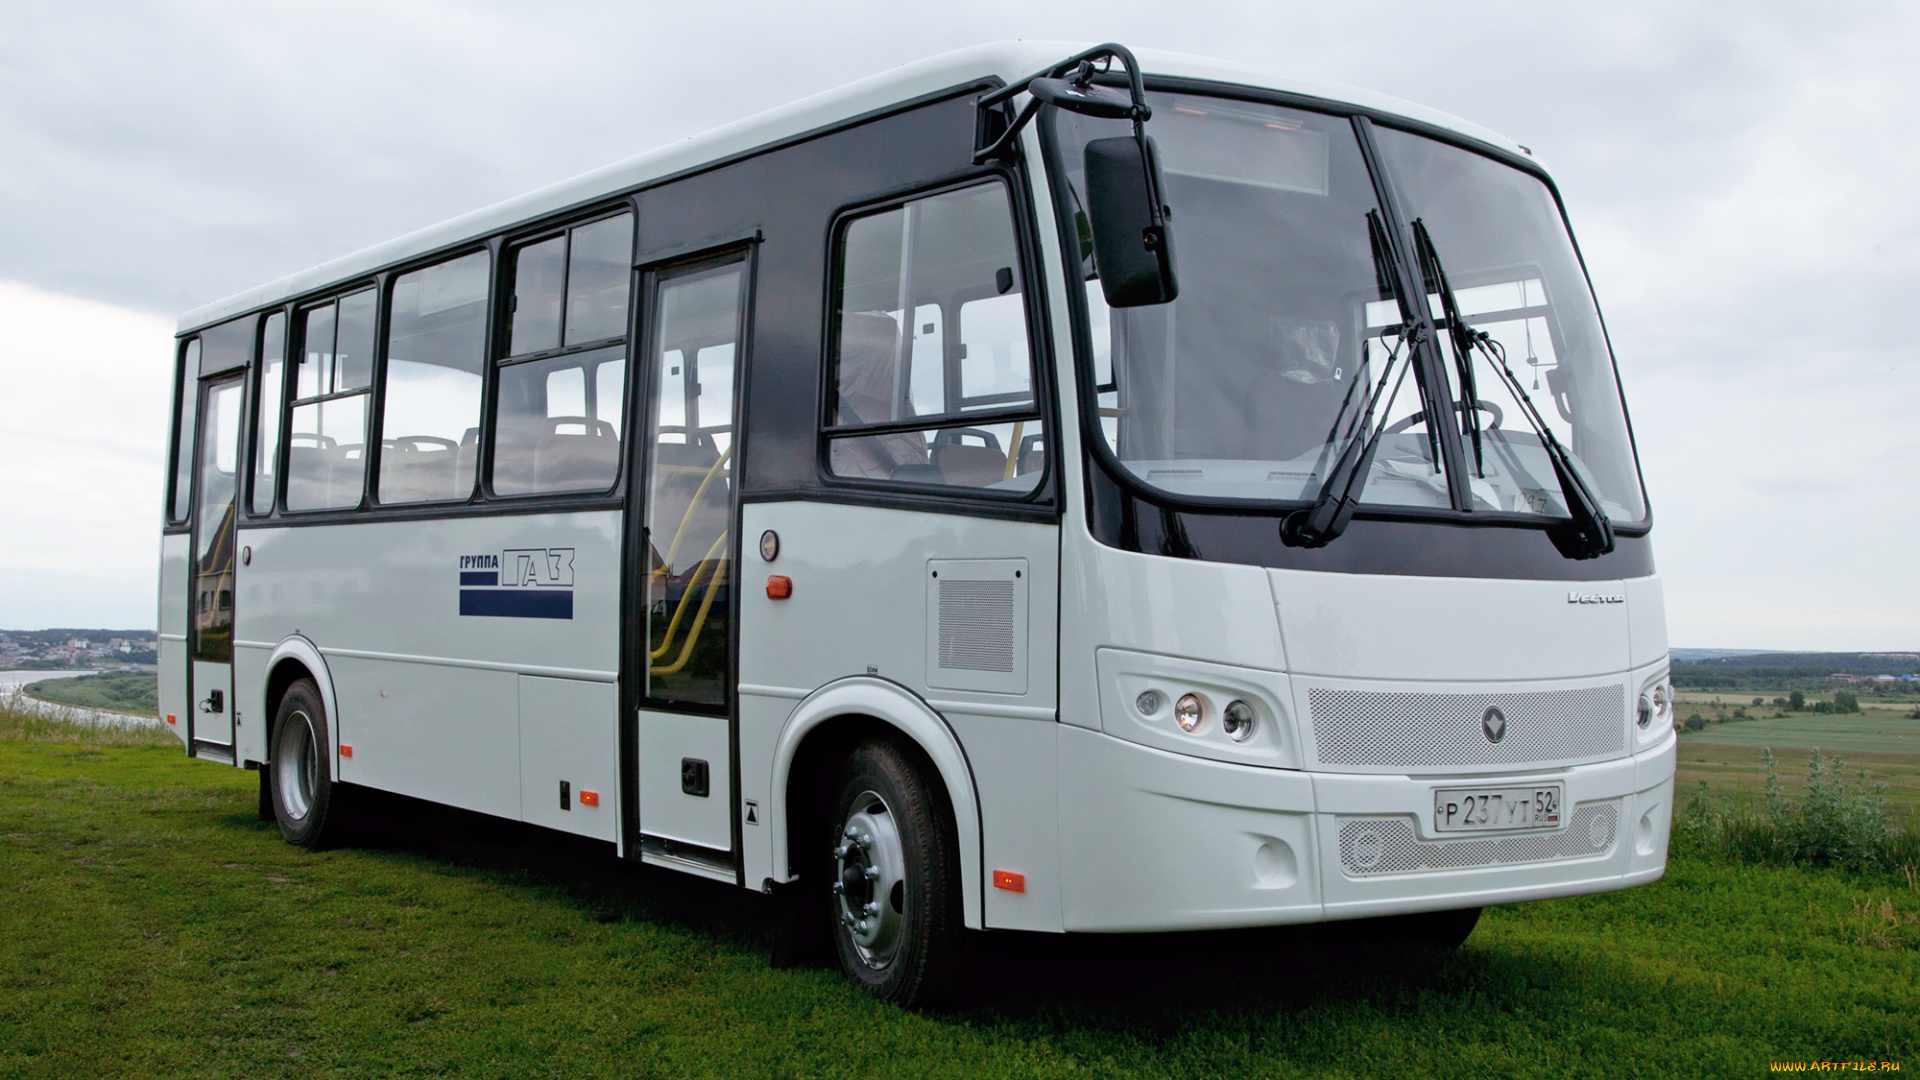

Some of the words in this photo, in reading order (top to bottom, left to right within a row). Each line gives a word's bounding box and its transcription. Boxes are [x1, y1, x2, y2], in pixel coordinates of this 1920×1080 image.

[460, 555, 499, 569] ГРУППА
[502, 547, 575, 587] ГАЗ
[1536, 791, 1553, 813] 52
[1535, 813, 1548, 822] RUS
